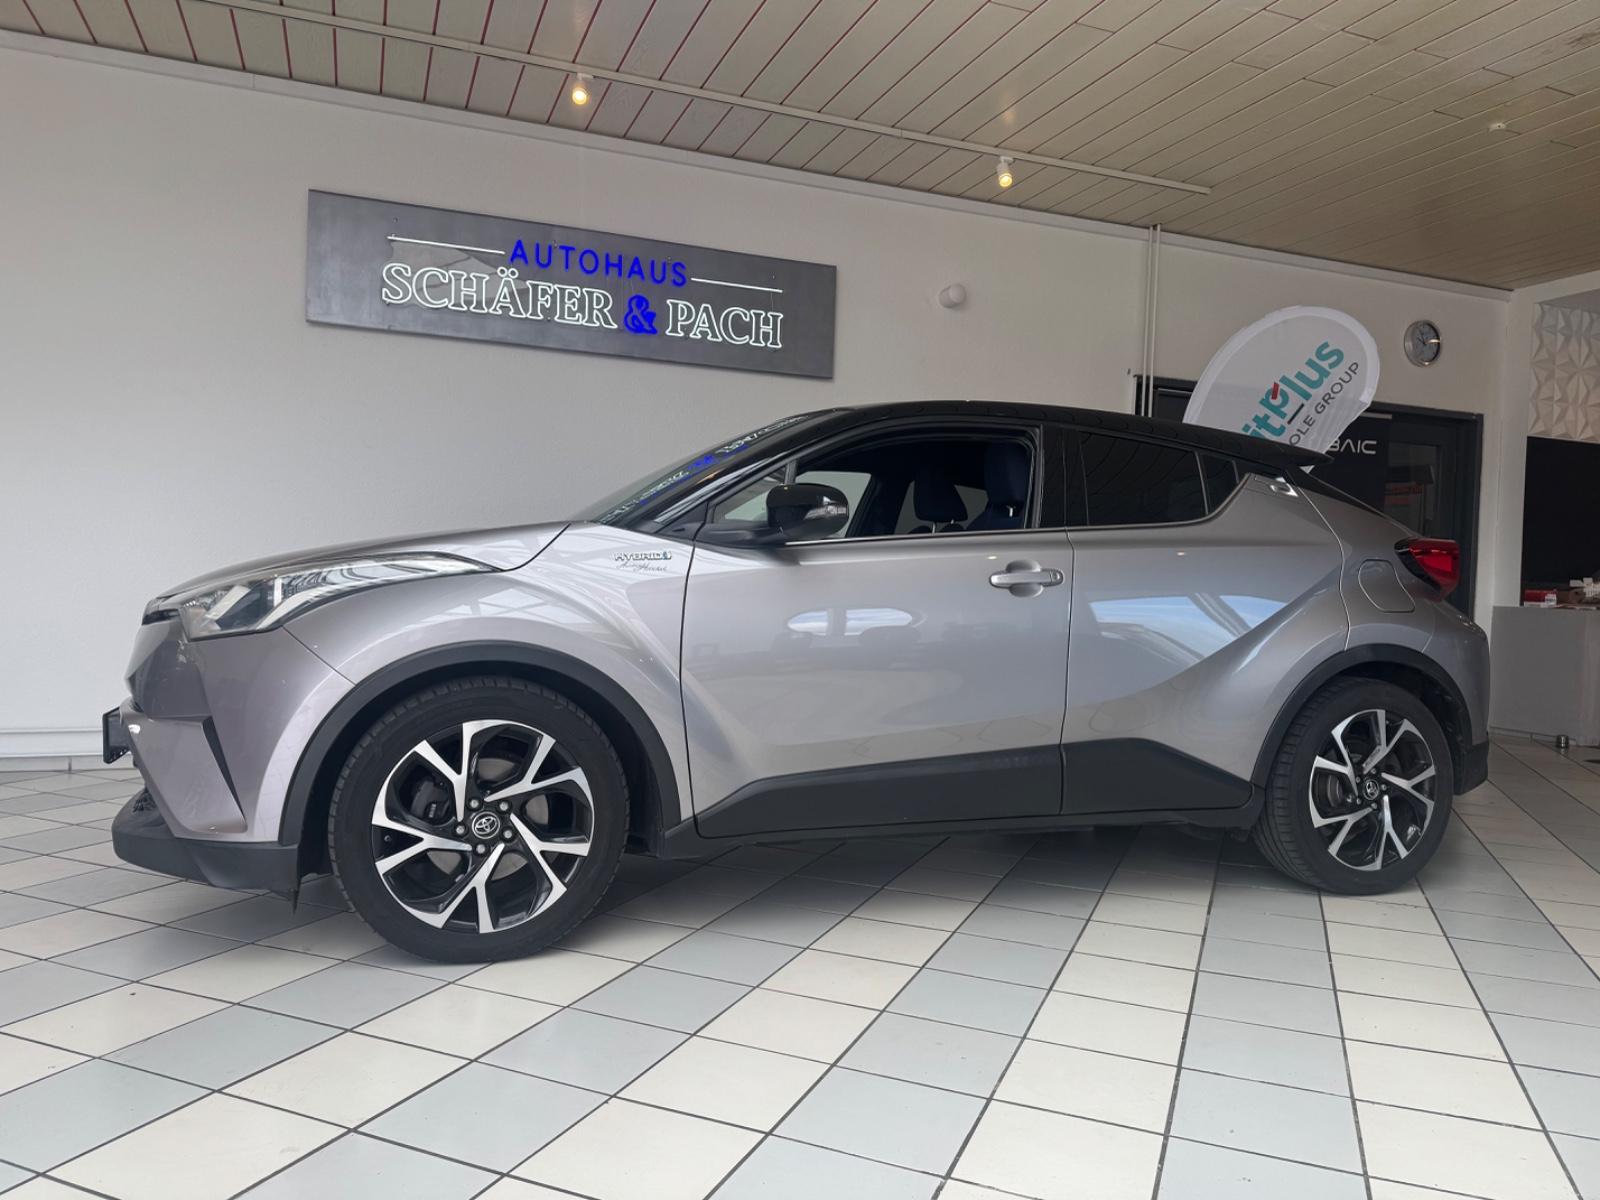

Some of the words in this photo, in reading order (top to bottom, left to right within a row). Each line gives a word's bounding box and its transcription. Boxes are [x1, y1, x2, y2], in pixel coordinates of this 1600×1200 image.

[509, 240, 688, 288] AUTOHAUS
[381, 263, 618, 329] SCHÄFER
[623, 294, 658, 335] &
[665, 299, 784, 348] PACH
[1314, 362, 1359, 415] GROUP
